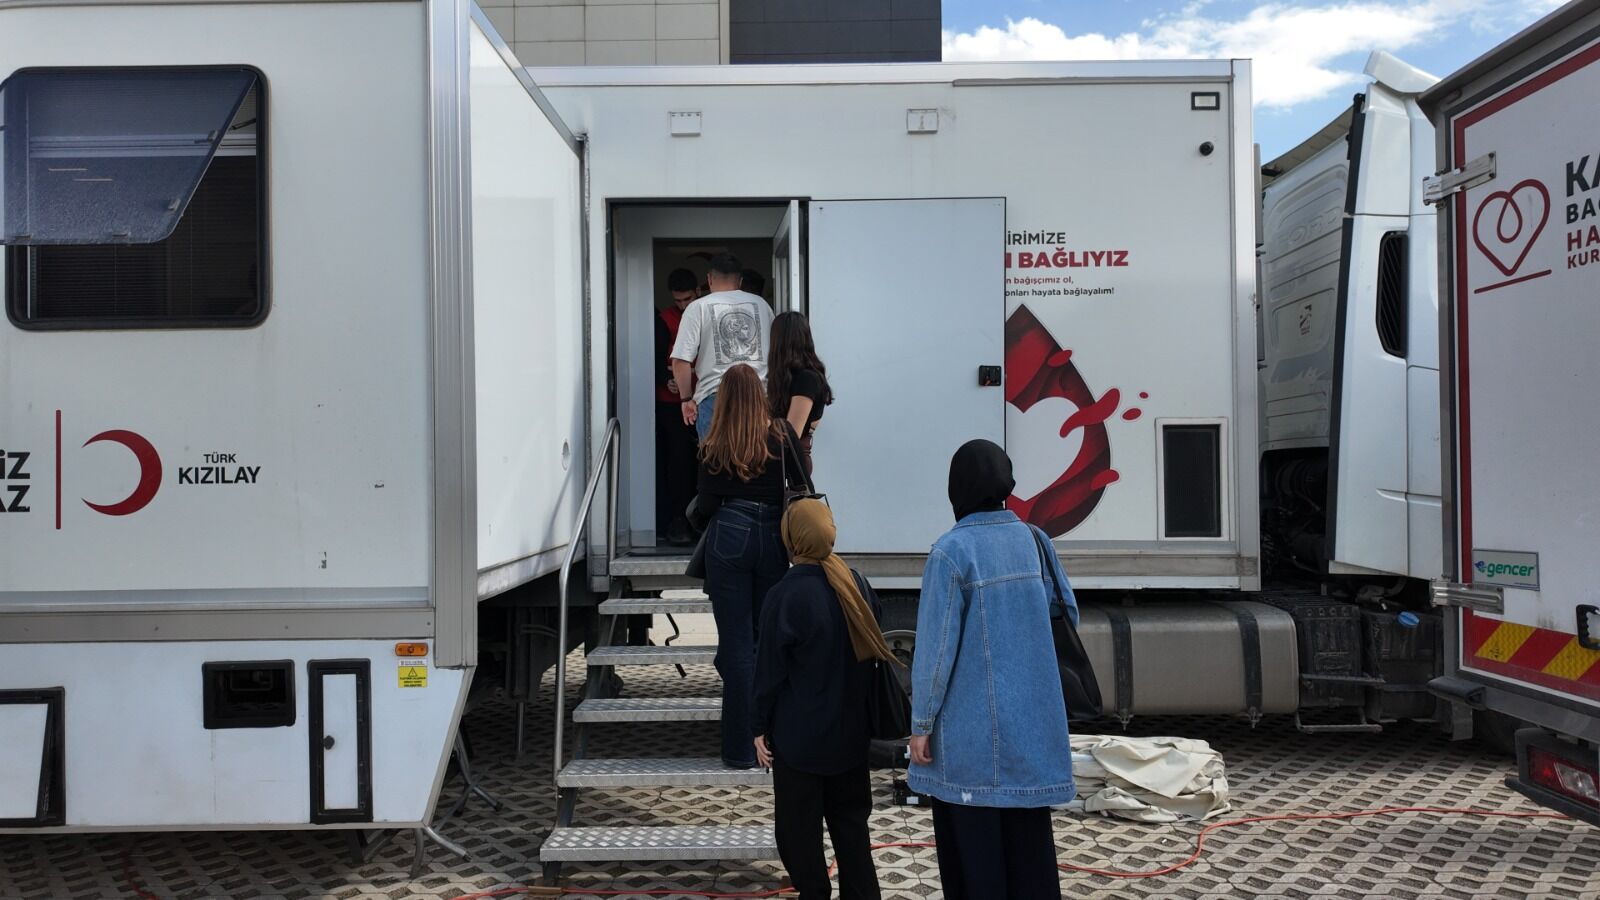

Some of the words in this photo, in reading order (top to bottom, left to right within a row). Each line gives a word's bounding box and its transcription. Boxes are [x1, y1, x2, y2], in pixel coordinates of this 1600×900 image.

[1566, 198, 1600, 225] BA
[1018, 247, 1128, 268] BAĞLIYIZ
[1568, 248, 1600, 269] KUR
[1013, 276, 1060, 285] bağışçımız
[1062, 276, 1074, 284] ol,
[1031, 289, 1061, 298] hayata
[1063, 287, 1114, 297] bağlayalım!
[203, 451, 237, 464] TÜRK
[179, 466, 261, 485] KIZILAY
[0, 485, 31, 513] Z
[1486, 562, 1535, 578] gencer
